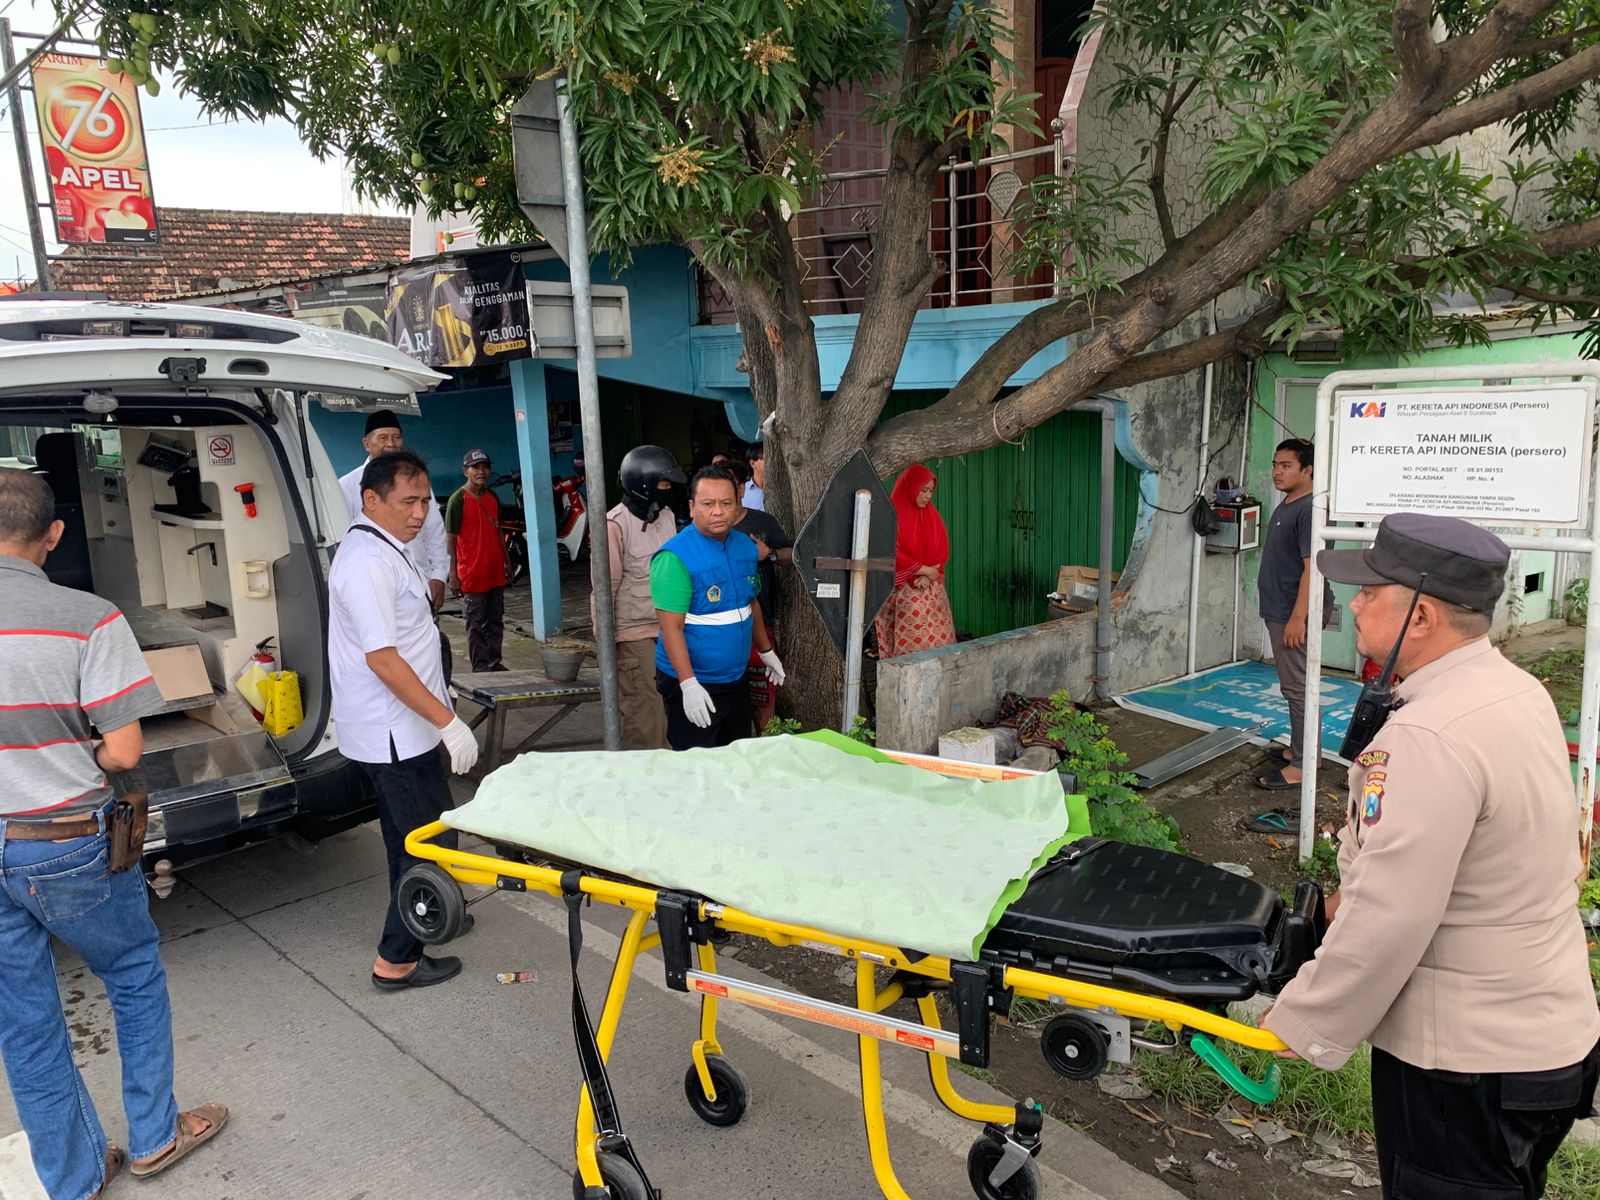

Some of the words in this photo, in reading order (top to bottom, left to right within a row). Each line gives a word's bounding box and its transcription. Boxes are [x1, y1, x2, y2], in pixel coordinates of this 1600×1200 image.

[59, 87, 116, 150] 76
[60, 166, 141, 190] APEL
[475, 290, 525, 308] GENGGAMAN
[1350, 402, 1387, 418] KAI
[1411, 403, 1444, 411] KERETA
[1461, 402, 1508, 410] INDONESIA
[1510, 401, 1549, 410] (Persero)
[1416, 433, 1456, 443] TANAH
[1459, 433, 1493, 443] MILIK
[1351, 445, 1367, 455] PT.
[1370, 446, 1415, 455] KERETA
[1417, 446, 1436, 455] API
[1440, 446, 1507, 455] INDONESIA
[1510, 446, 1567, 458] (persero)
